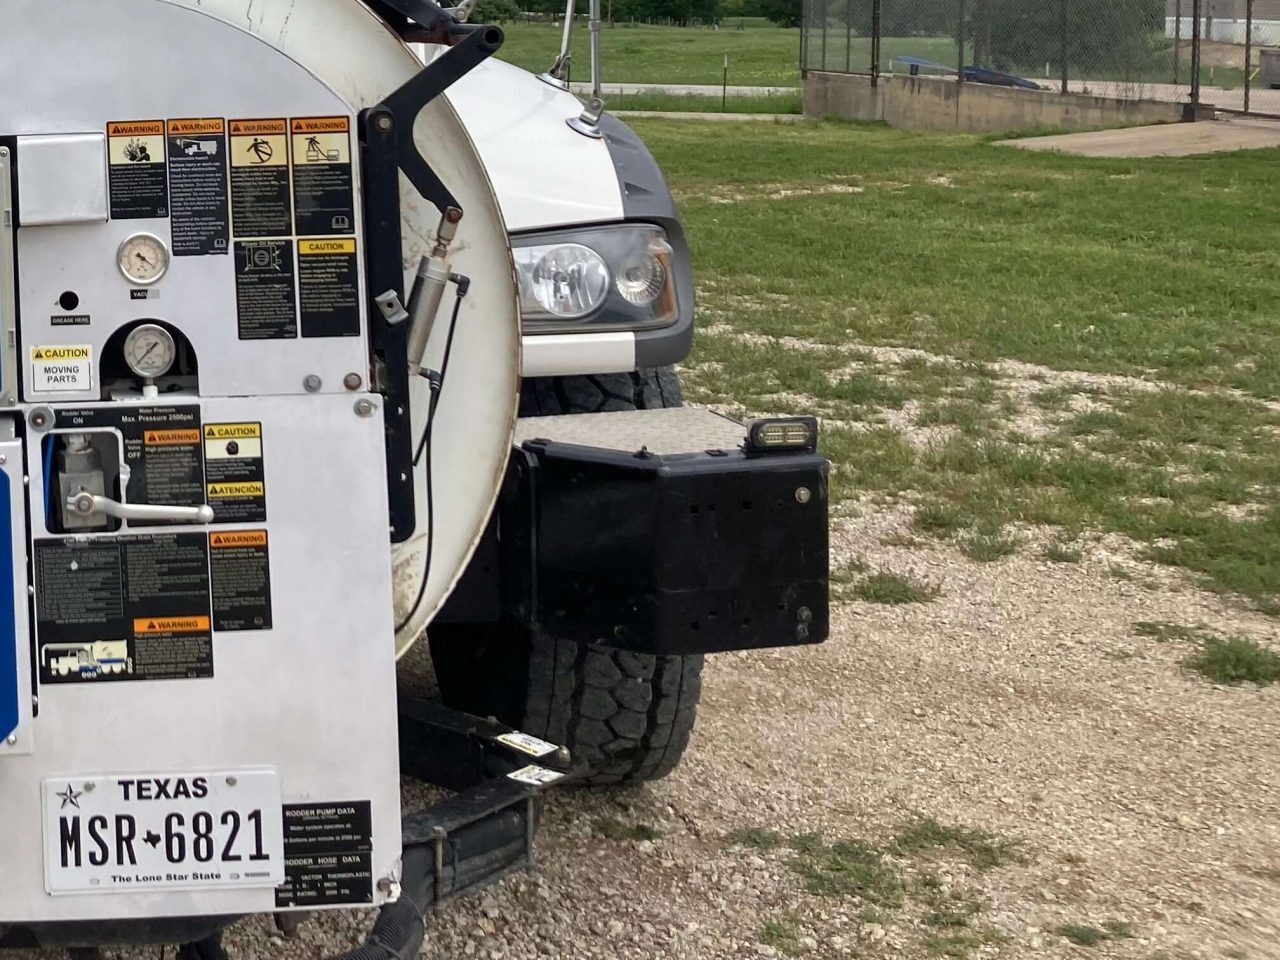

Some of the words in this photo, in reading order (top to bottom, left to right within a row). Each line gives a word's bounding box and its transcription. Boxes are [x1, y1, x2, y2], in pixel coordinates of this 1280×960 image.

[120, 125, 160, 134] WARNING
[180, 121, 221, 131] WARNING
[243, 123, 284, 132] WARNING
[305, 121, 346, 130] WARNING
[308, 243, 344, 251] CAUTION
[45, 348, 88, 358] CAUTION
[44, 366, 80, 374] MOVING
[47, 374, 77, 383] PARTS
[218, 427, 256, 436] CAUTION
[158, 432, 198, 441] WARNING
[222, 534, 264, 544] WARNING
[118, 777, 208, 801] TEXAS
[316, 808, 336, 816] PUMP
[60, 813, 137, 868] MSR
[164, 809, 270, 864] 6821
[318, 856, 338, 864] HOSE
[111, 875, 132, 883] The
[136, 874, 162, 882] Lone
[166, 873, 188, 881] Star
[192, 872, 222, 880] State
